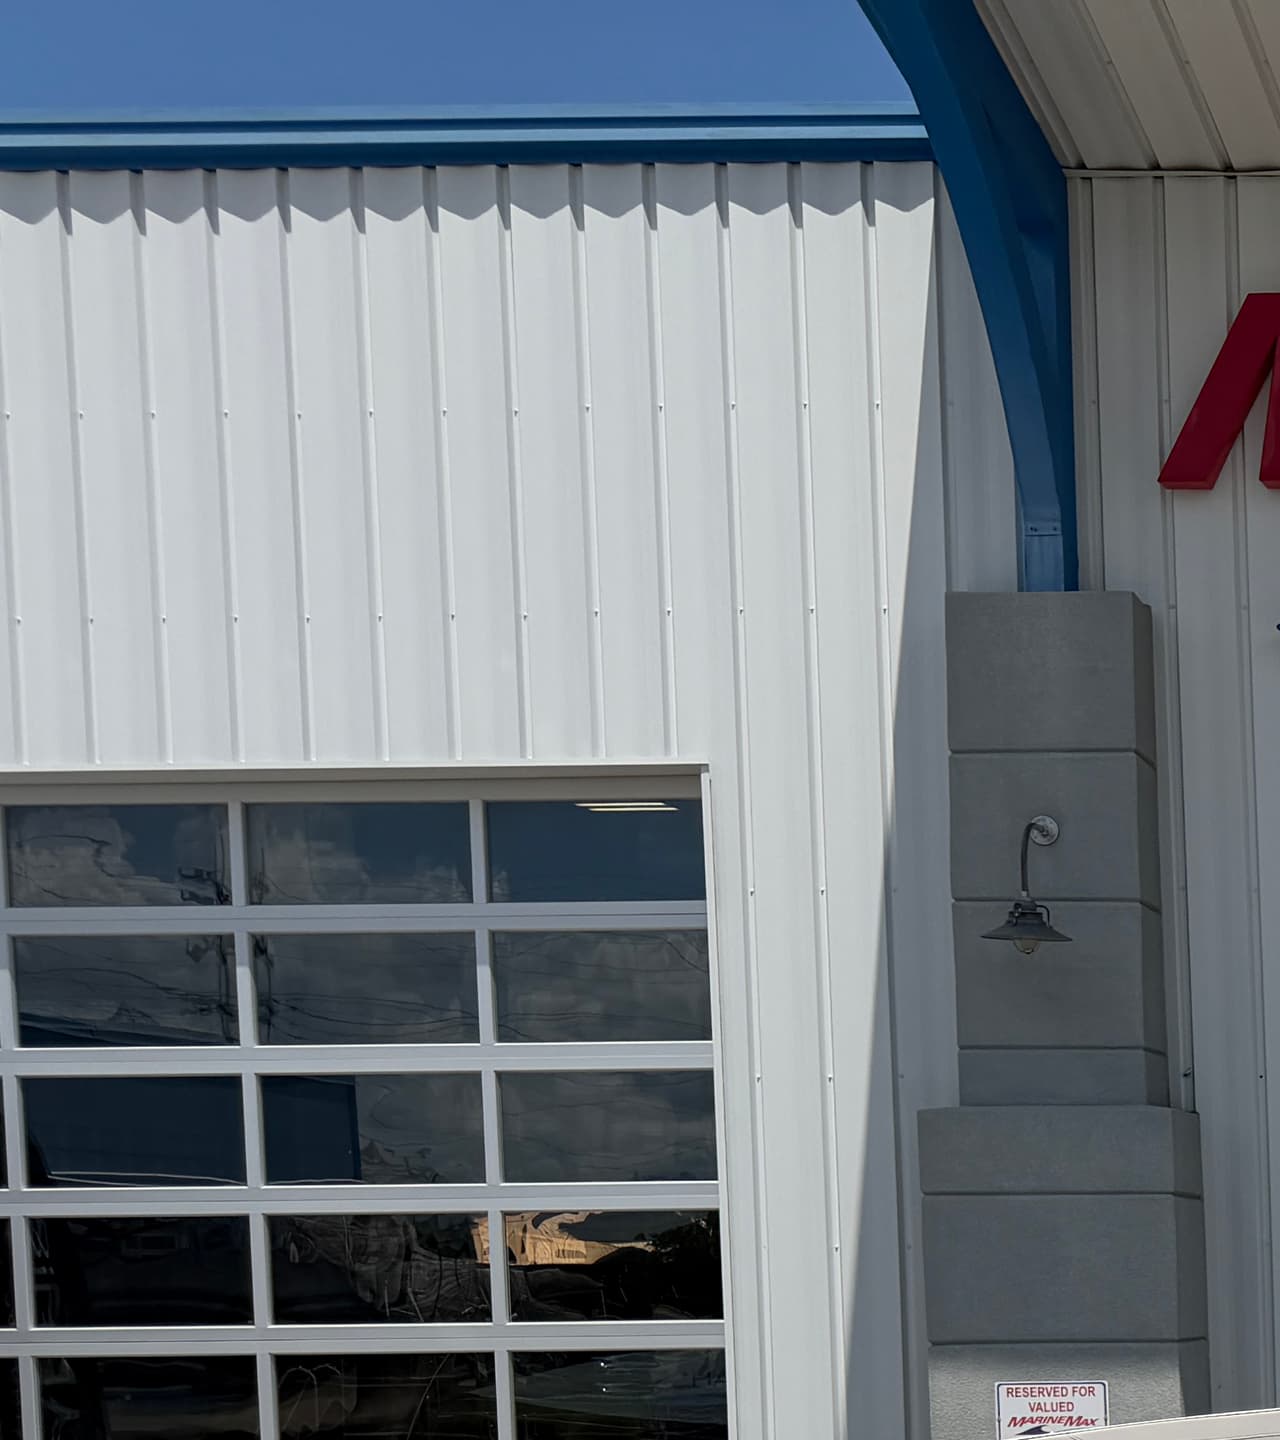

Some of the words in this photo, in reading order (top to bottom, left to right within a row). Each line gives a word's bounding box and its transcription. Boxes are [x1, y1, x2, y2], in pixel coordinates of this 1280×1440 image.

[1006, 1386, 1069, 1398] RESERVED
[1072, 1386, 1096, 1397] FOR
[1028, 1401, 1074, 1413] VALUED
